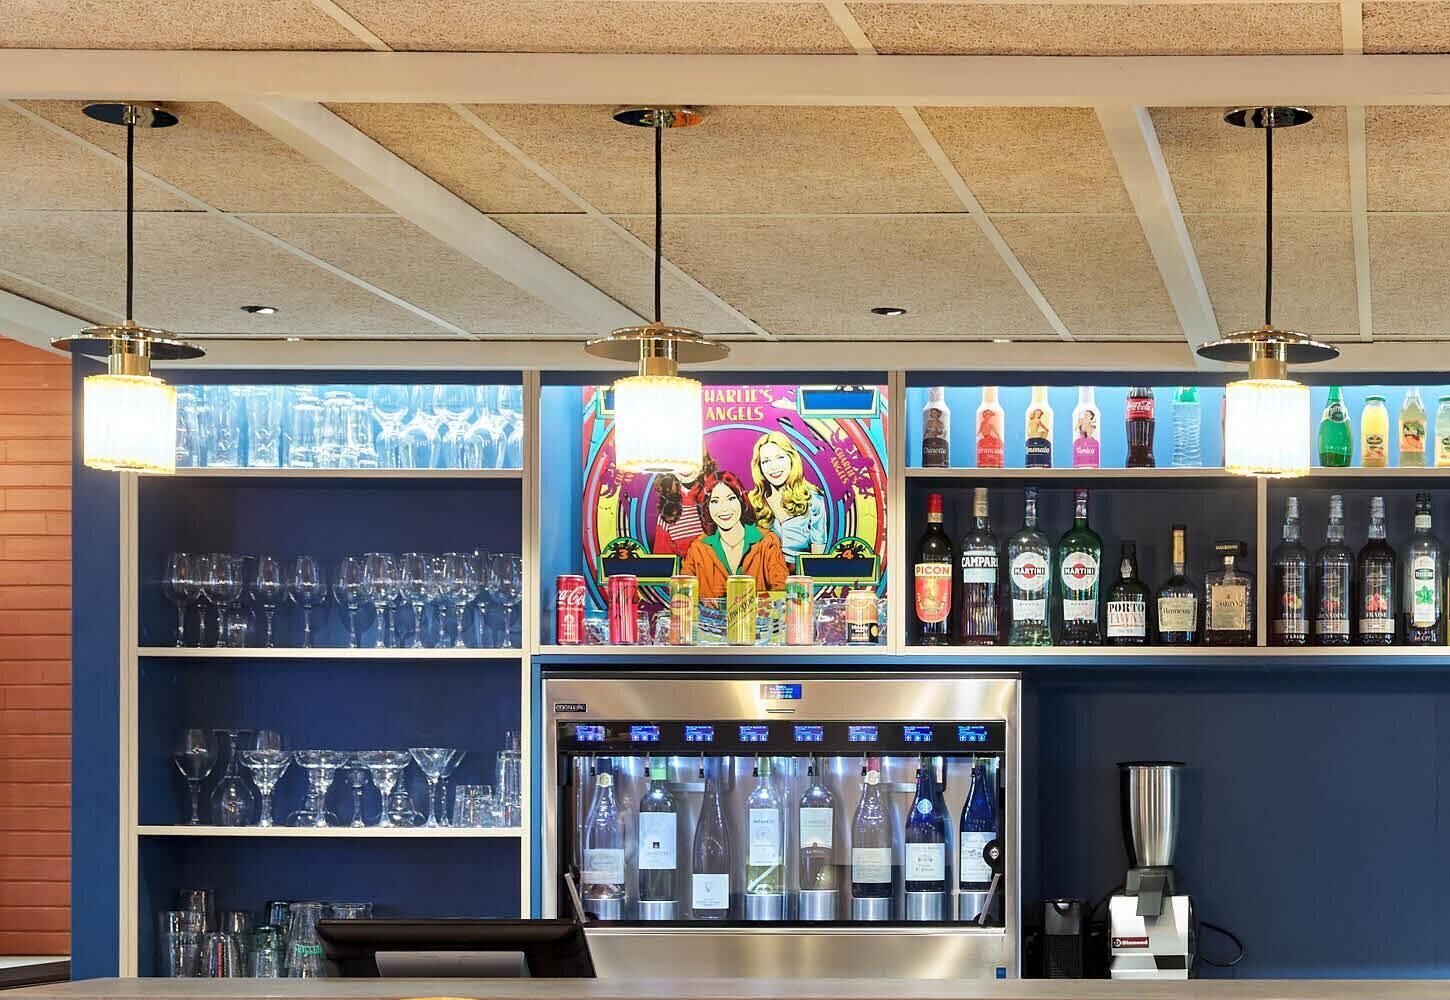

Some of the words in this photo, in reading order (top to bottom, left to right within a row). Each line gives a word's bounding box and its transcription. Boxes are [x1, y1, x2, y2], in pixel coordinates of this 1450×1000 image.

[703, 388, 773, 403] HARLIE'S
[704, 406, 764, 421] ANGELS
[830, 456, 849, 485] ANGELS
[618, 548, 629, 560] 3
[842, 549, 853, 559] 4
[915, 565, 950, 576] PICON
[1013, 566, 1045, 575] MARTINI
[1063, 566, 1095, 575] MARTINI
[1109, 602, 1145, 613] PORTO
[1162, 606, 1191, 616] Hennessy
